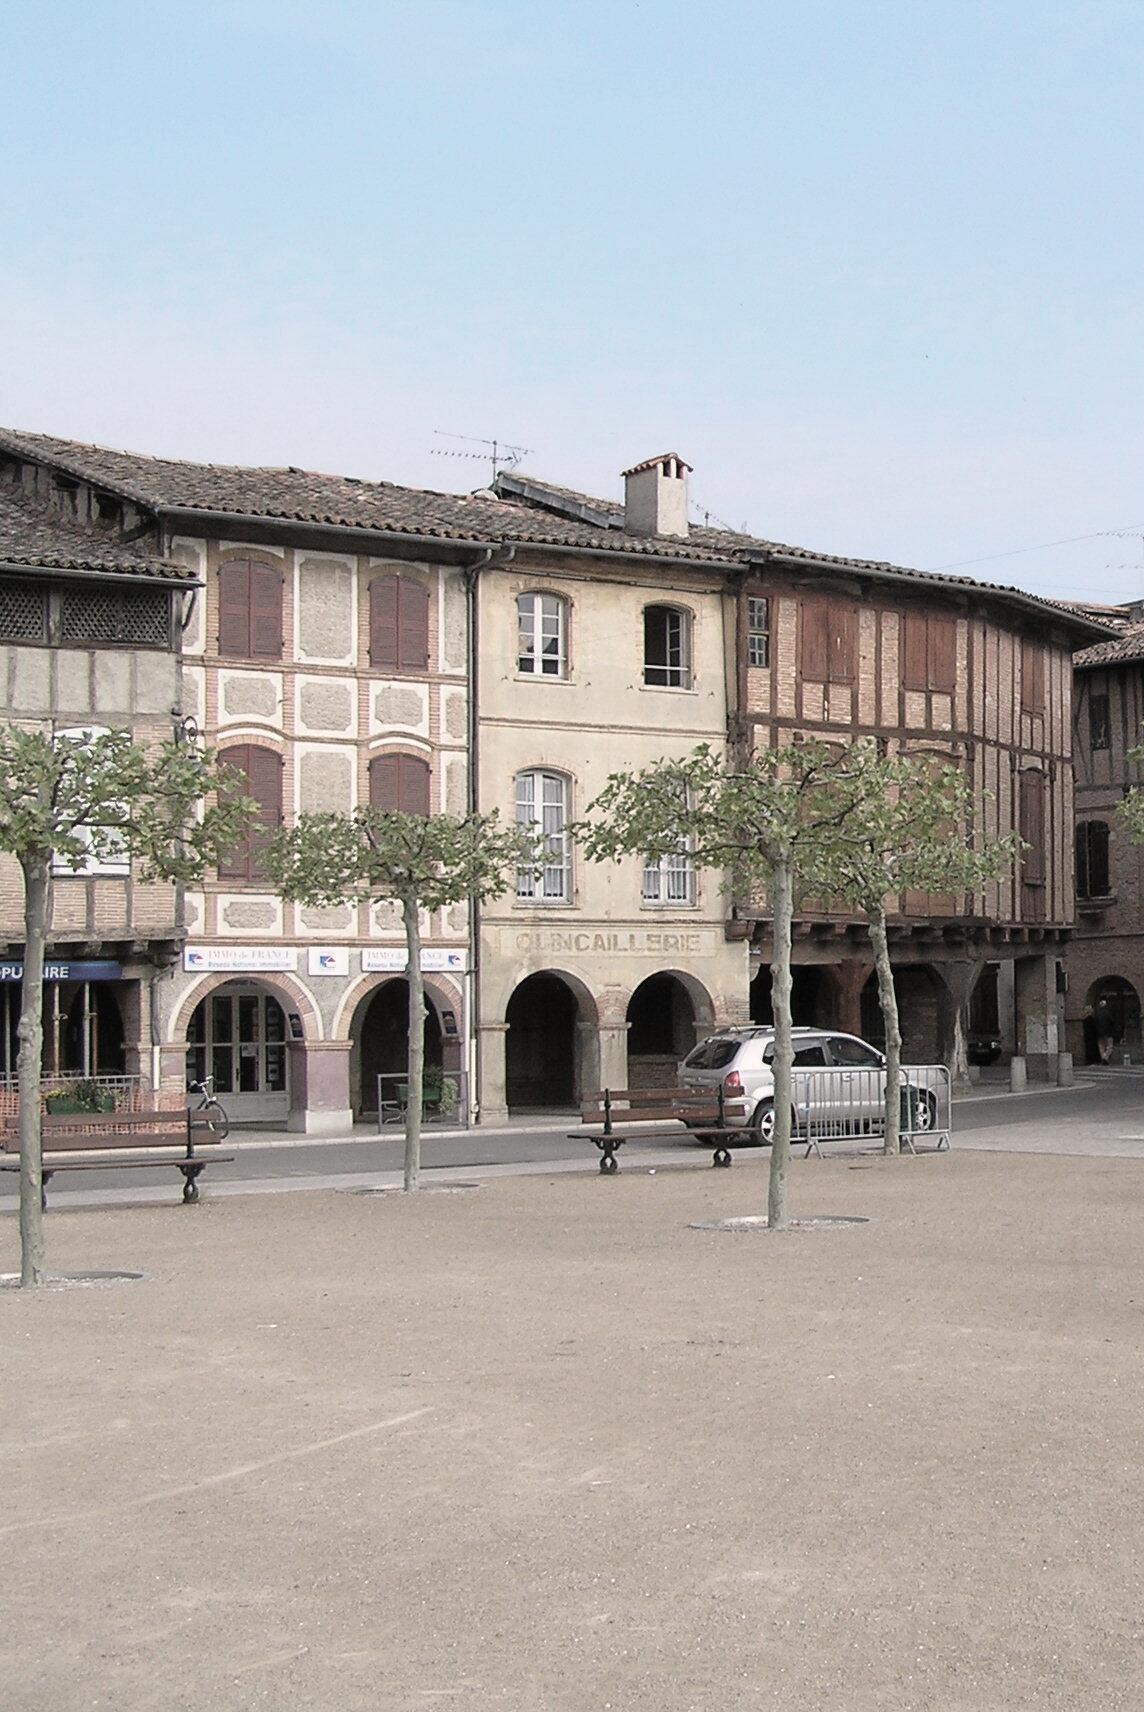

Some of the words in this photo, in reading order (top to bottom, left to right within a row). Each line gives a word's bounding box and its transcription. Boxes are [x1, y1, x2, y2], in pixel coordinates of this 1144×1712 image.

[515, 933, 701, 952] QUINCAILLERIE
[208, 950, 237, 959] IMMO
[251, 950, 290, 959] FRANCE
[0, 966, 69, 979] PUIRE
